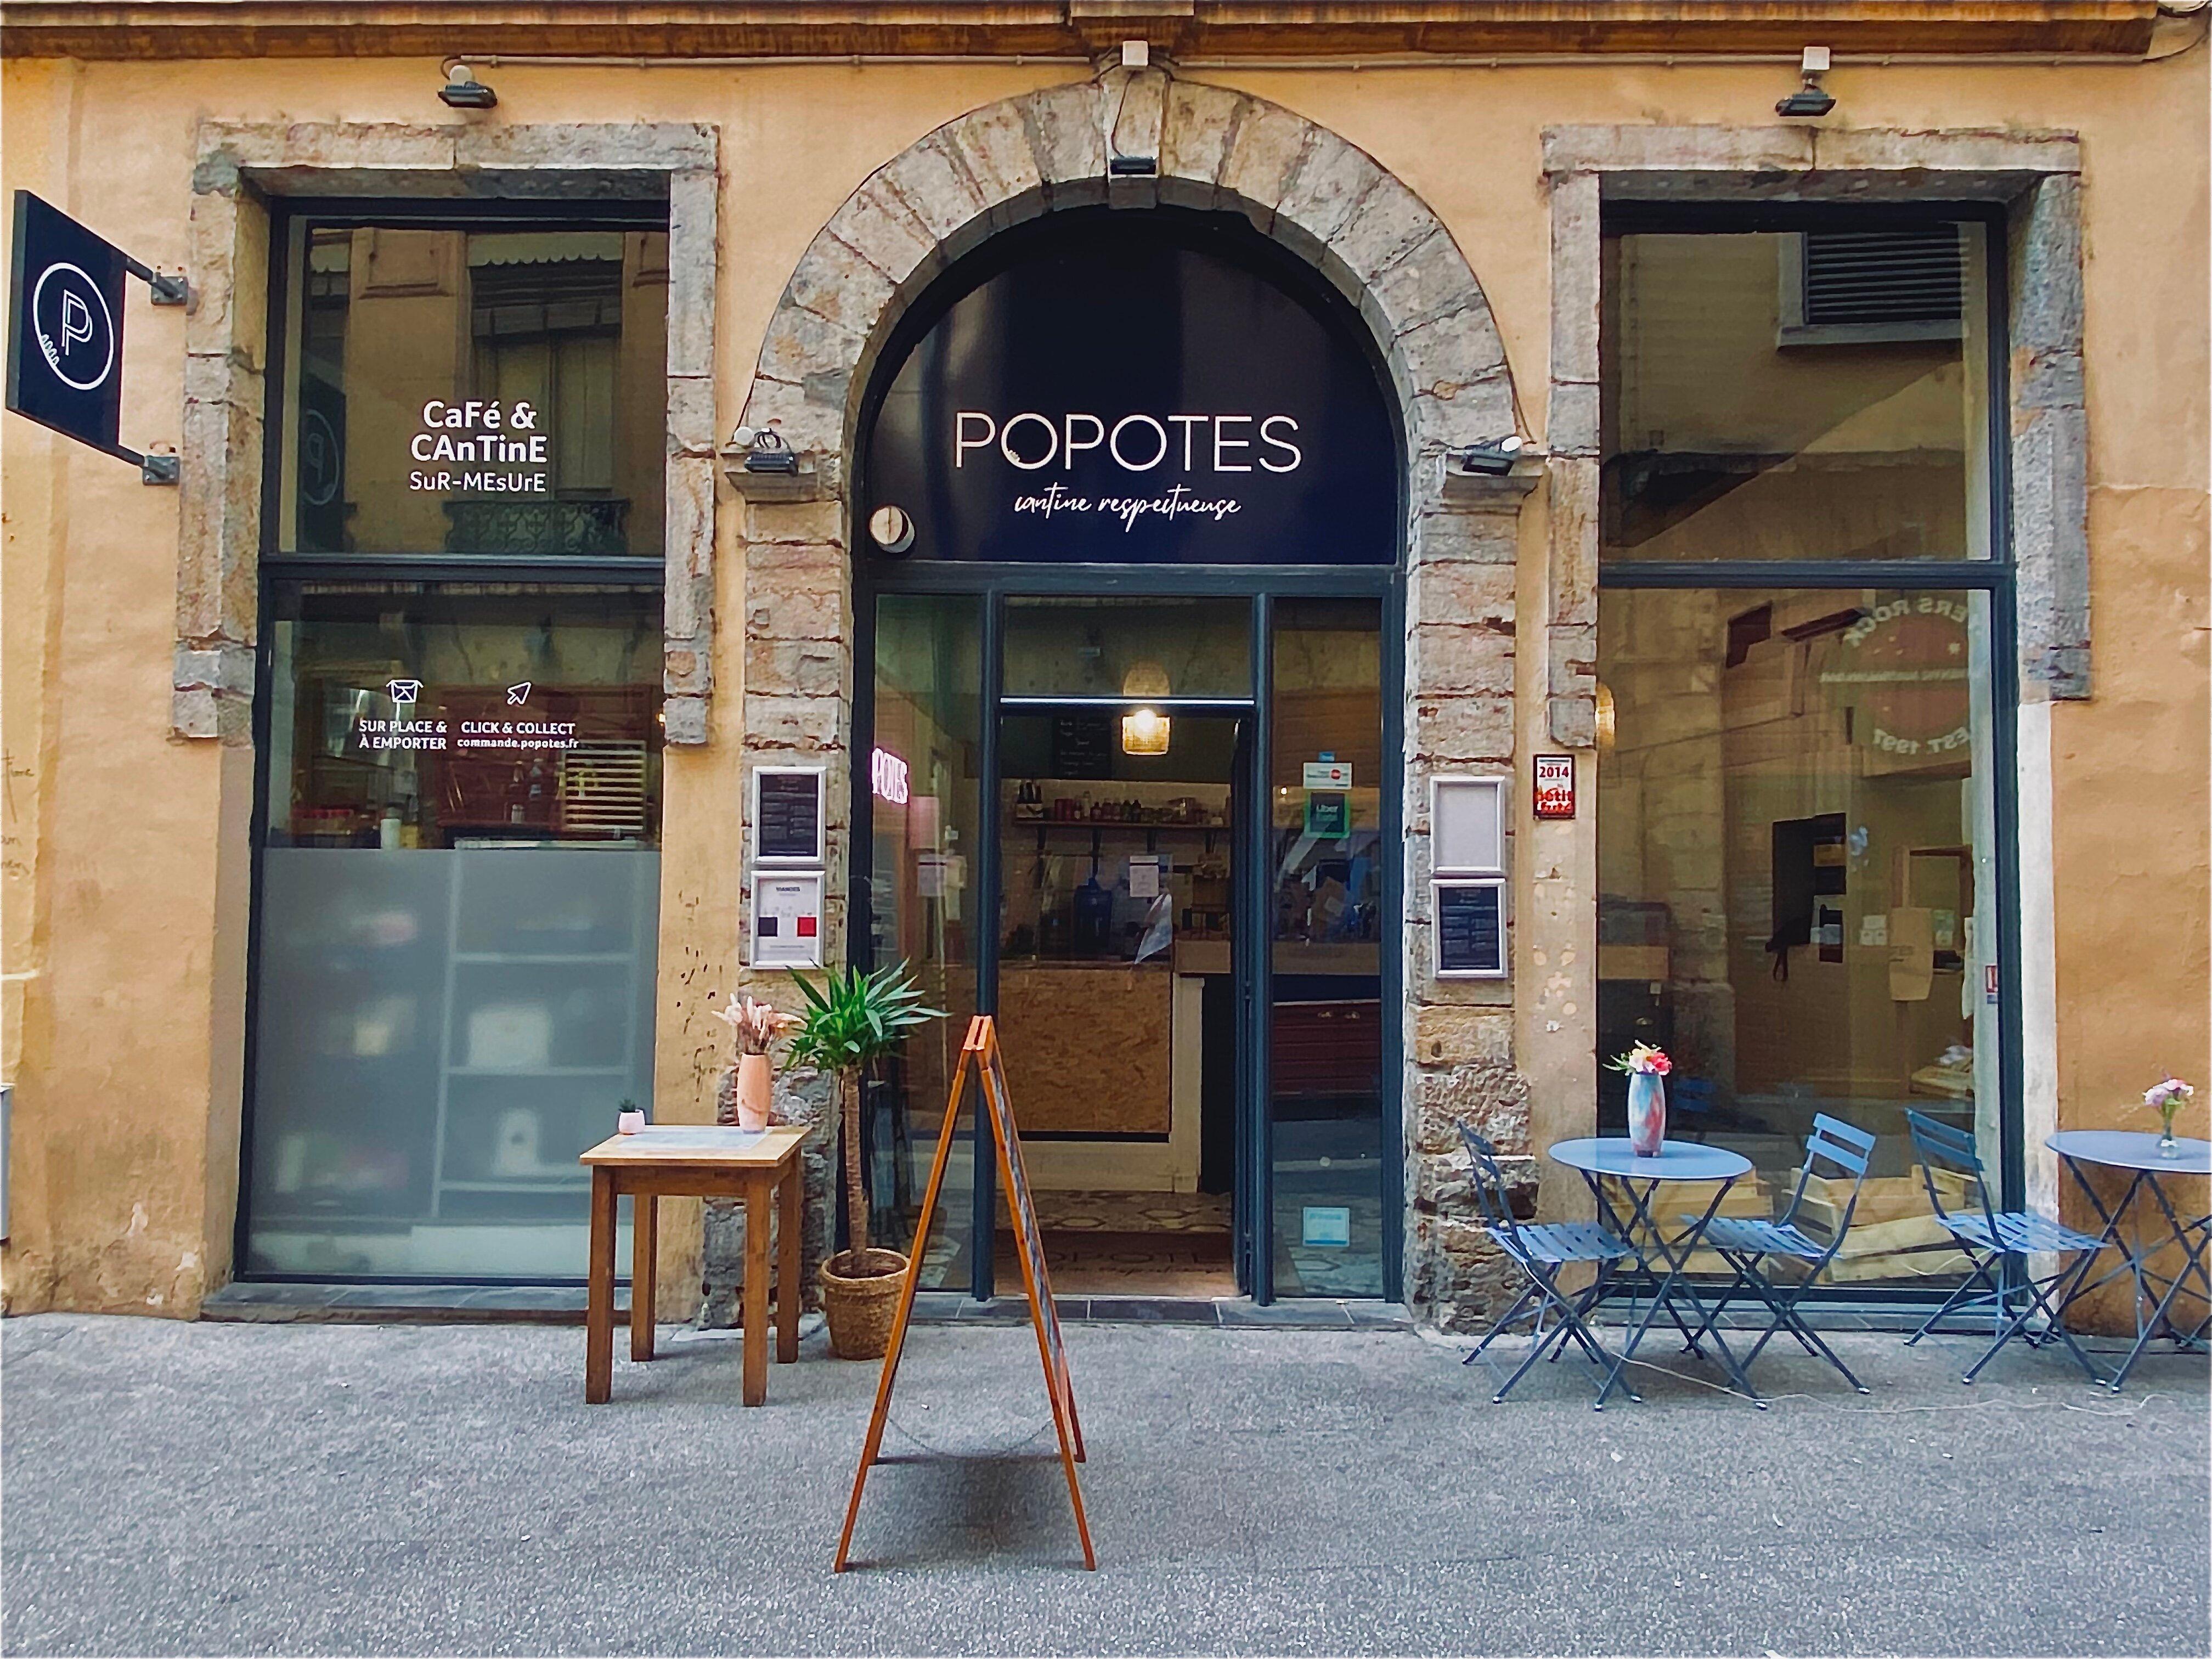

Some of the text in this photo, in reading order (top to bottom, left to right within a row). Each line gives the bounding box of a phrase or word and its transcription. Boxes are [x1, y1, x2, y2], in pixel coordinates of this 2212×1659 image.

[424, 400, 537, 429] CaFé &
[411, 434, 548, 463] CAnTinE
[956, 412, 1302, 473] POPOTES
[410, 471, 546, 492] SuR-MEsUrE
[1014, 482, 1092, 519] cantine
[359, 720, 448, 733] SUR PLACE &
[461, 721, 576, 735] CLICK & COLLECT
[358, 734, 447, 750] À EMPORTER
[457, 737, 579, 751] commande.popotes.fr
[1539, 766, 1570, 778] 2014
